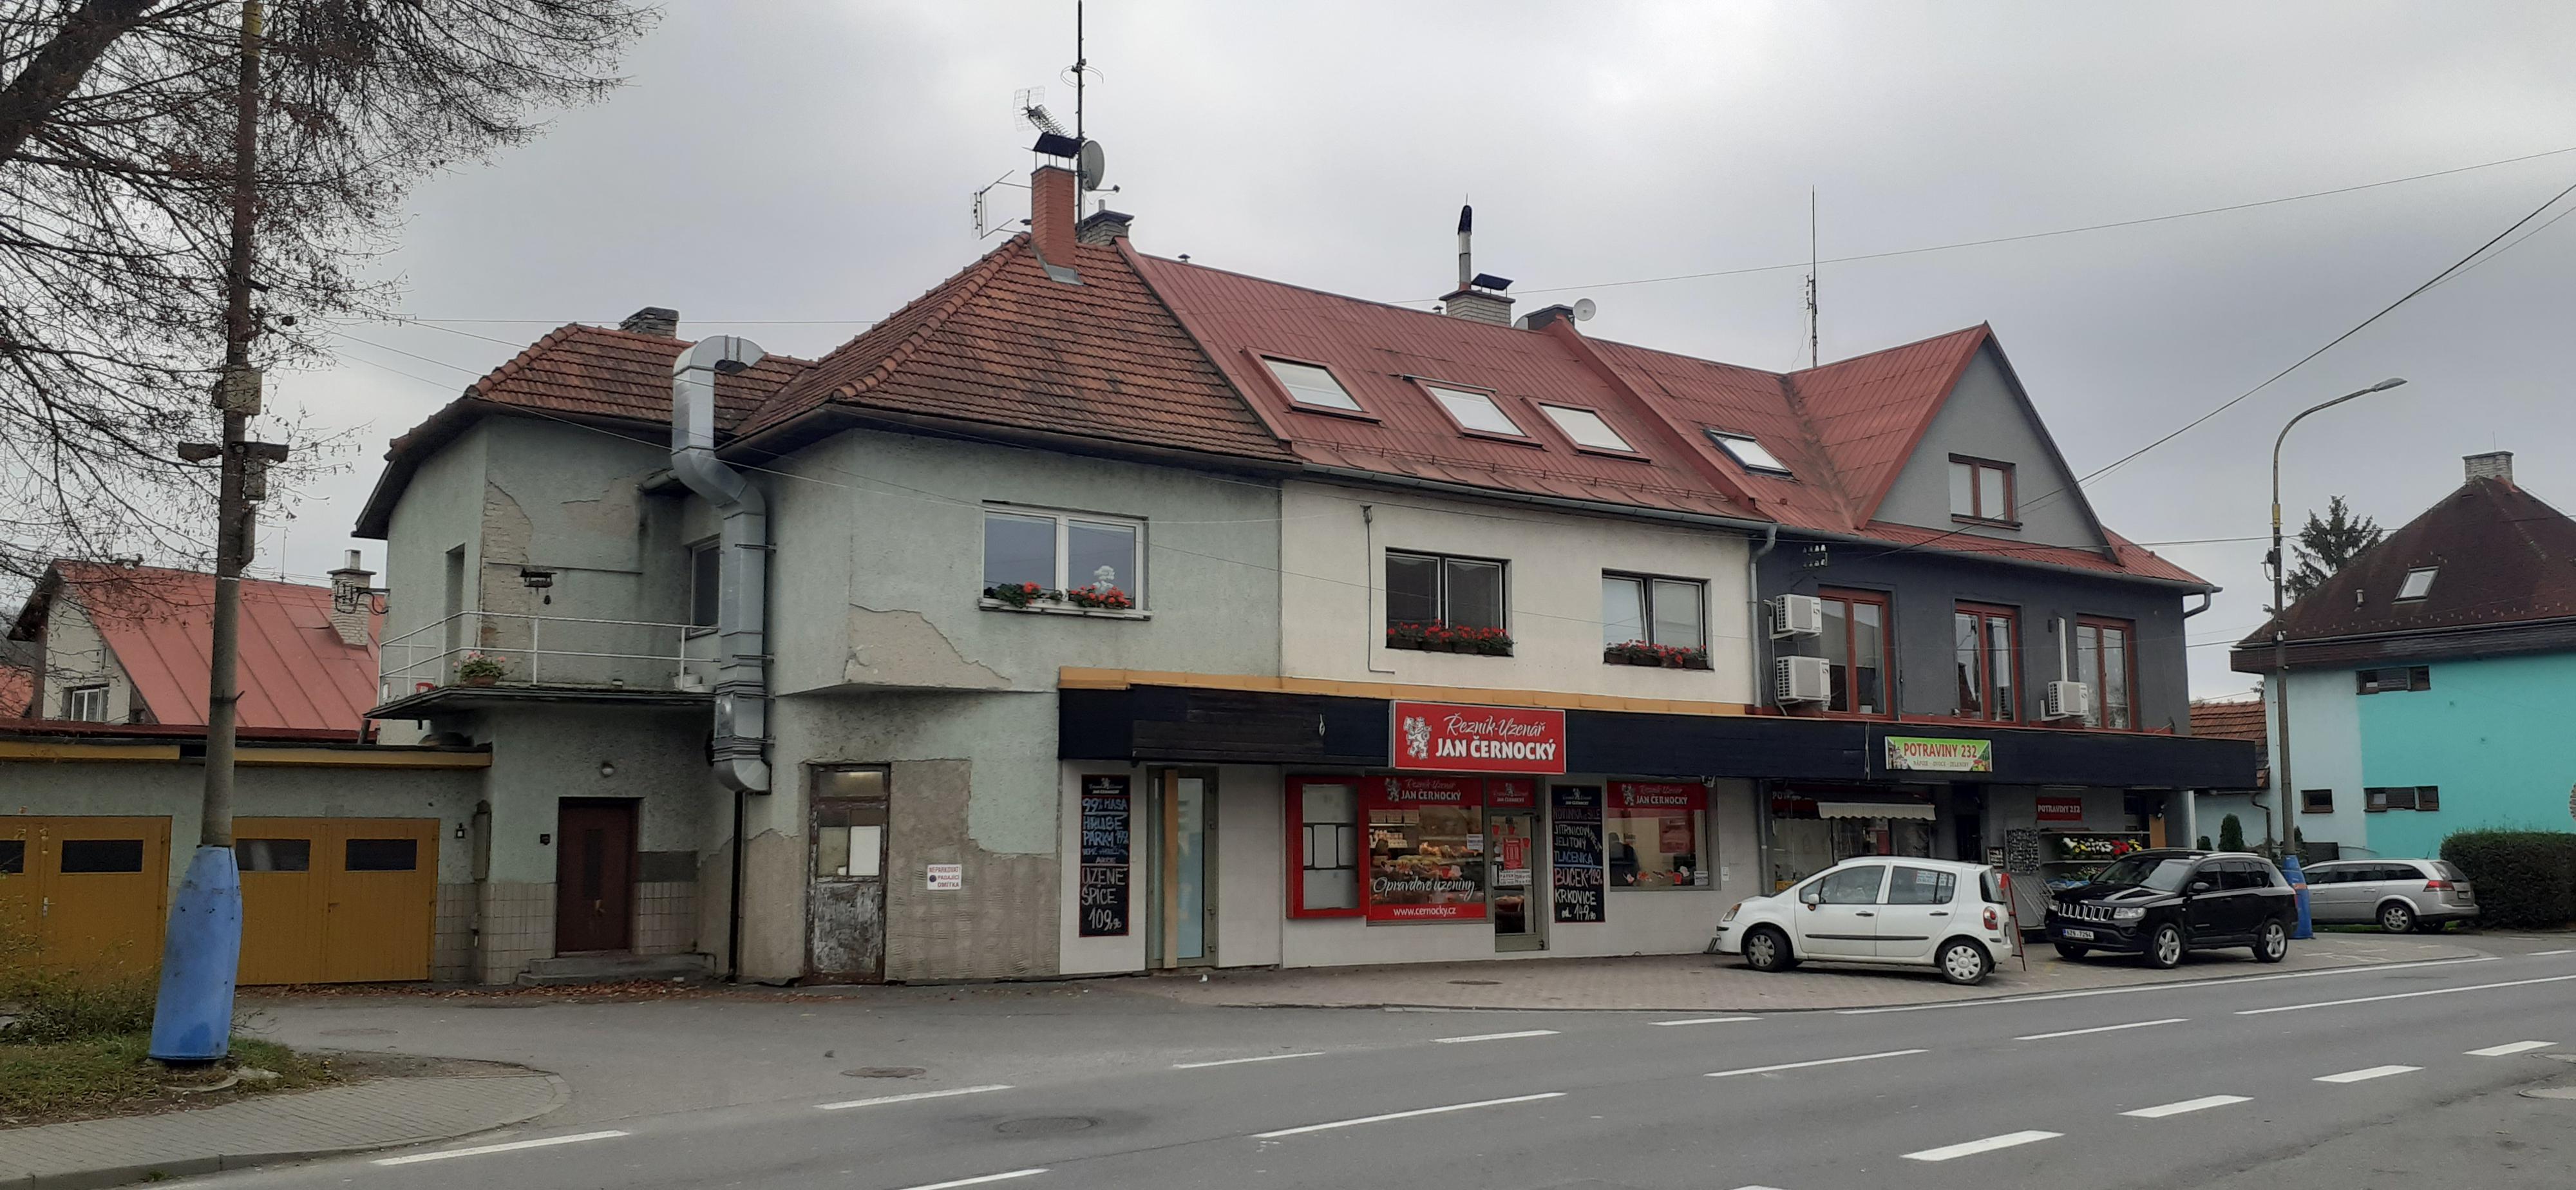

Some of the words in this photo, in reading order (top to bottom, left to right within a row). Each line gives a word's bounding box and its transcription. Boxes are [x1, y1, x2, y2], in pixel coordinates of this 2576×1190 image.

[1443, 713, 1546, 741] Řezník-Uzenář
[1435, 738, 1468, 757] JAN
[1470, 735, 1557, 760] ČERNOCKÝ
[1904, 742, 1958, 758] POTRAVINY
[1961, 744, 1977, 759] 232
[1401, 790, 1417, 800] JAN
[1418, 788, 1461, 801] ČERNOCKÝ
[1636, 795, 1649, 804] JAN
[1651, 793, 1688, 804] ČERNOCKÝ
[2038, 804, 2069, 813] POTRAVINY
[2070, 805, 2081, 813] 232
[1373, 876, 1432, 897] Opravdové
[1434, 877, 1475, 902] uzeniny
[1555, 889, 1597, 905] KRKOVICE
[1393, 905, 1457, 918] www.cernocky.cz
